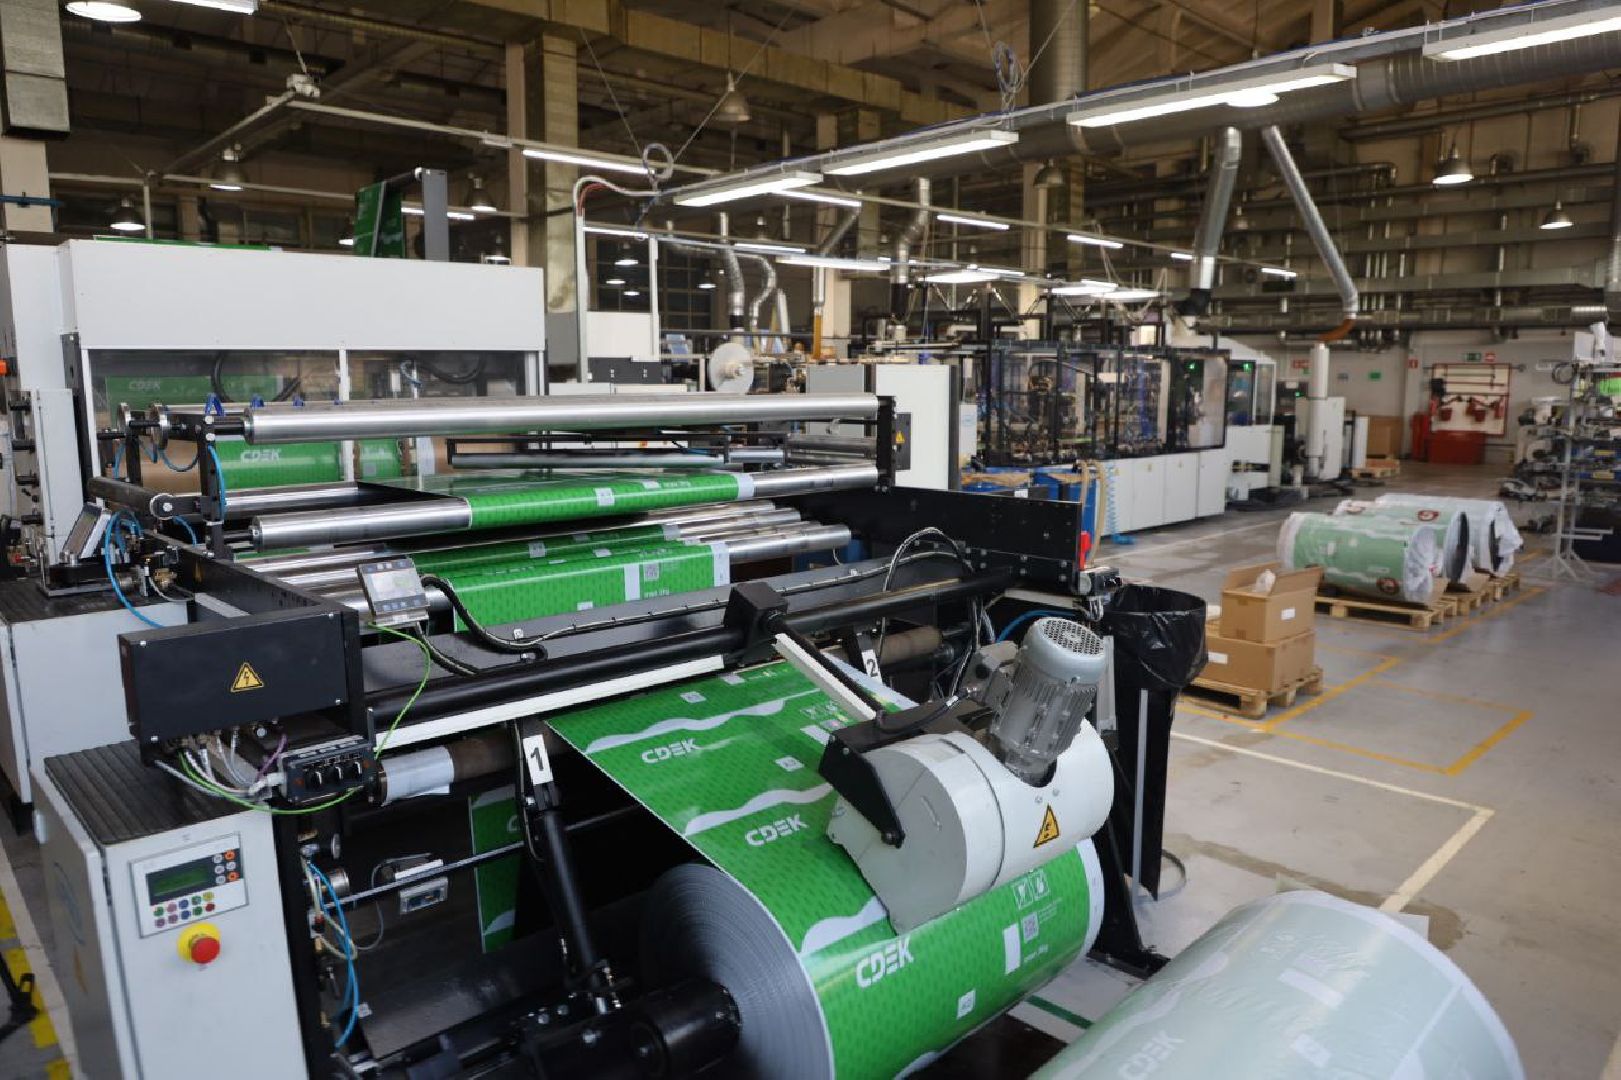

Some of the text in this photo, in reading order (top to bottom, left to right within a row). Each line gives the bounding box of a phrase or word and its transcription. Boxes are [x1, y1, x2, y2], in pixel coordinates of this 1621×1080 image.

[240, 448, 282, 464] CDEK
[867, 659, 878, 677] 2
[530, 747, 544, 772] 1
[641, 738, 701, 764] CDEK
[745, 814, 807, 847] CDEK
[856, 935, 914, 988] CDEK
[1118, 1030, 1185, 1080] CDEK
